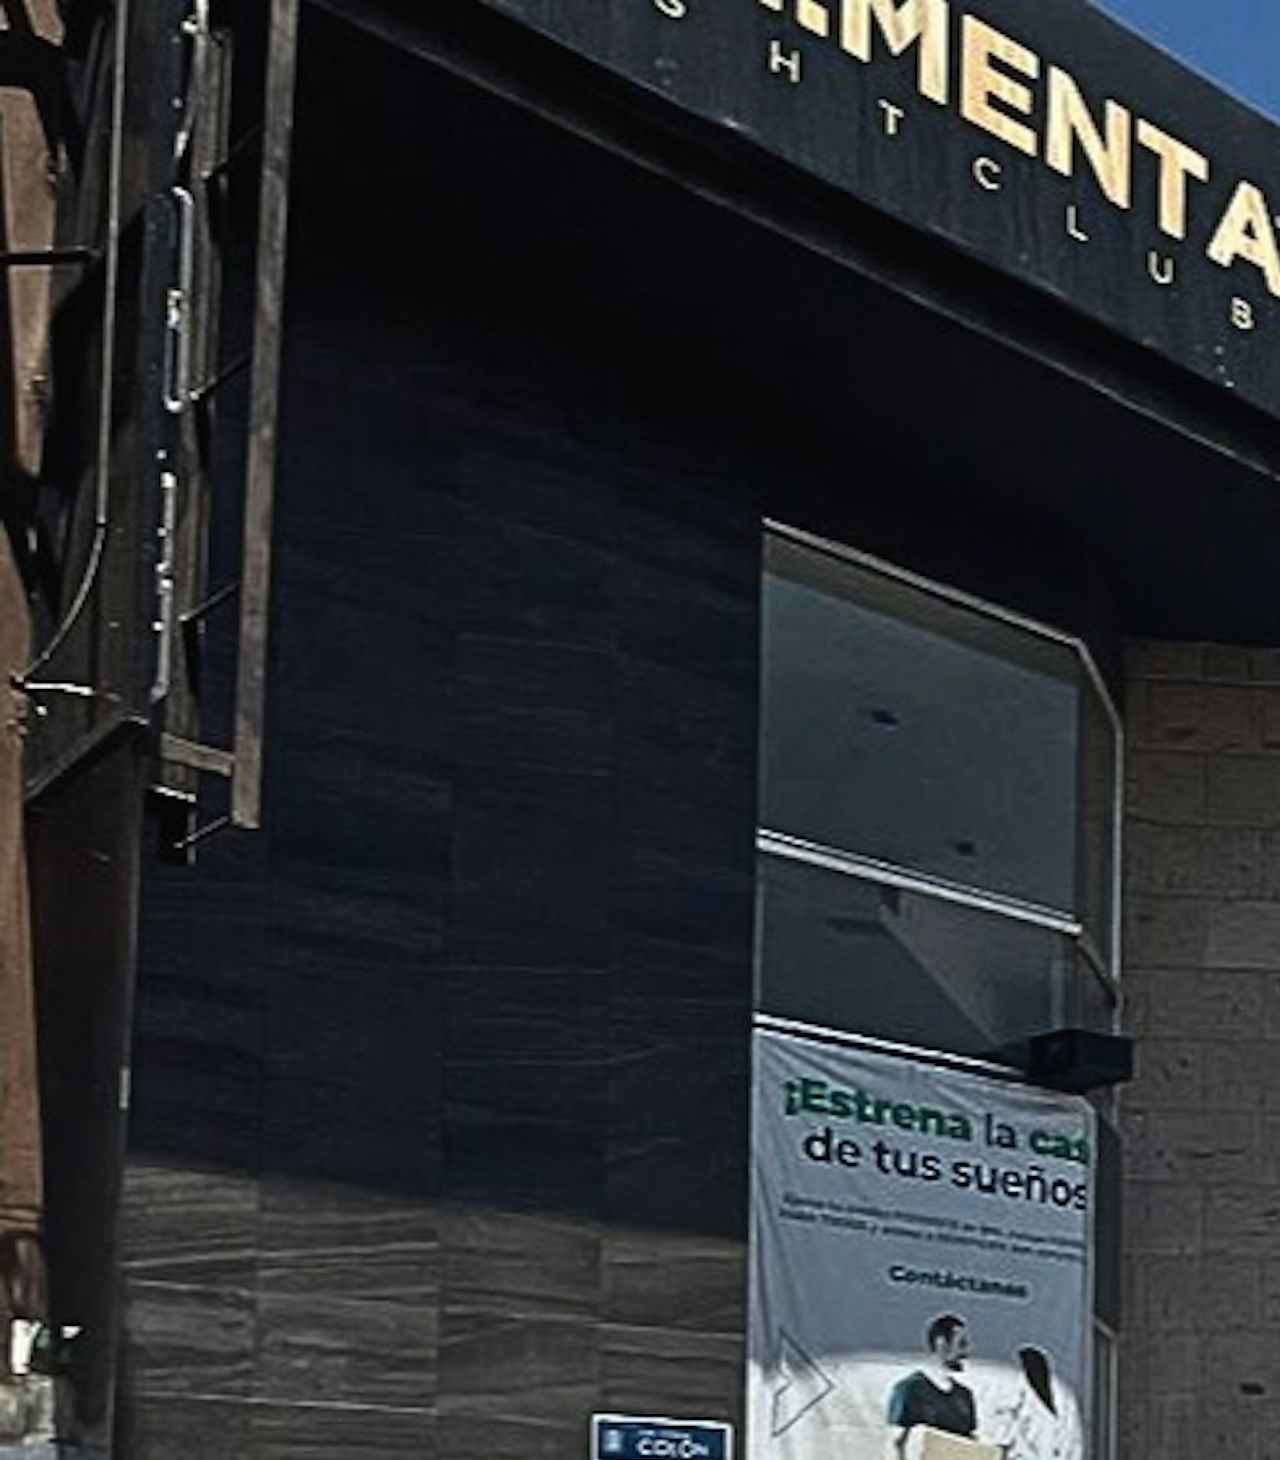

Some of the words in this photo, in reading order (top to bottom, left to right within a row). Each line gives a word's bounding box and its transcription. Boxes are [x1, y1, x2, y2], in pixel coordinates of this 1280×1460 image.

[985, 1113, 1016, 1149] la
[803, 1127, 861, 1168] de
[874, 1140, 942, 1182] tus
[951, 1161, 1087, 1211] sueños
